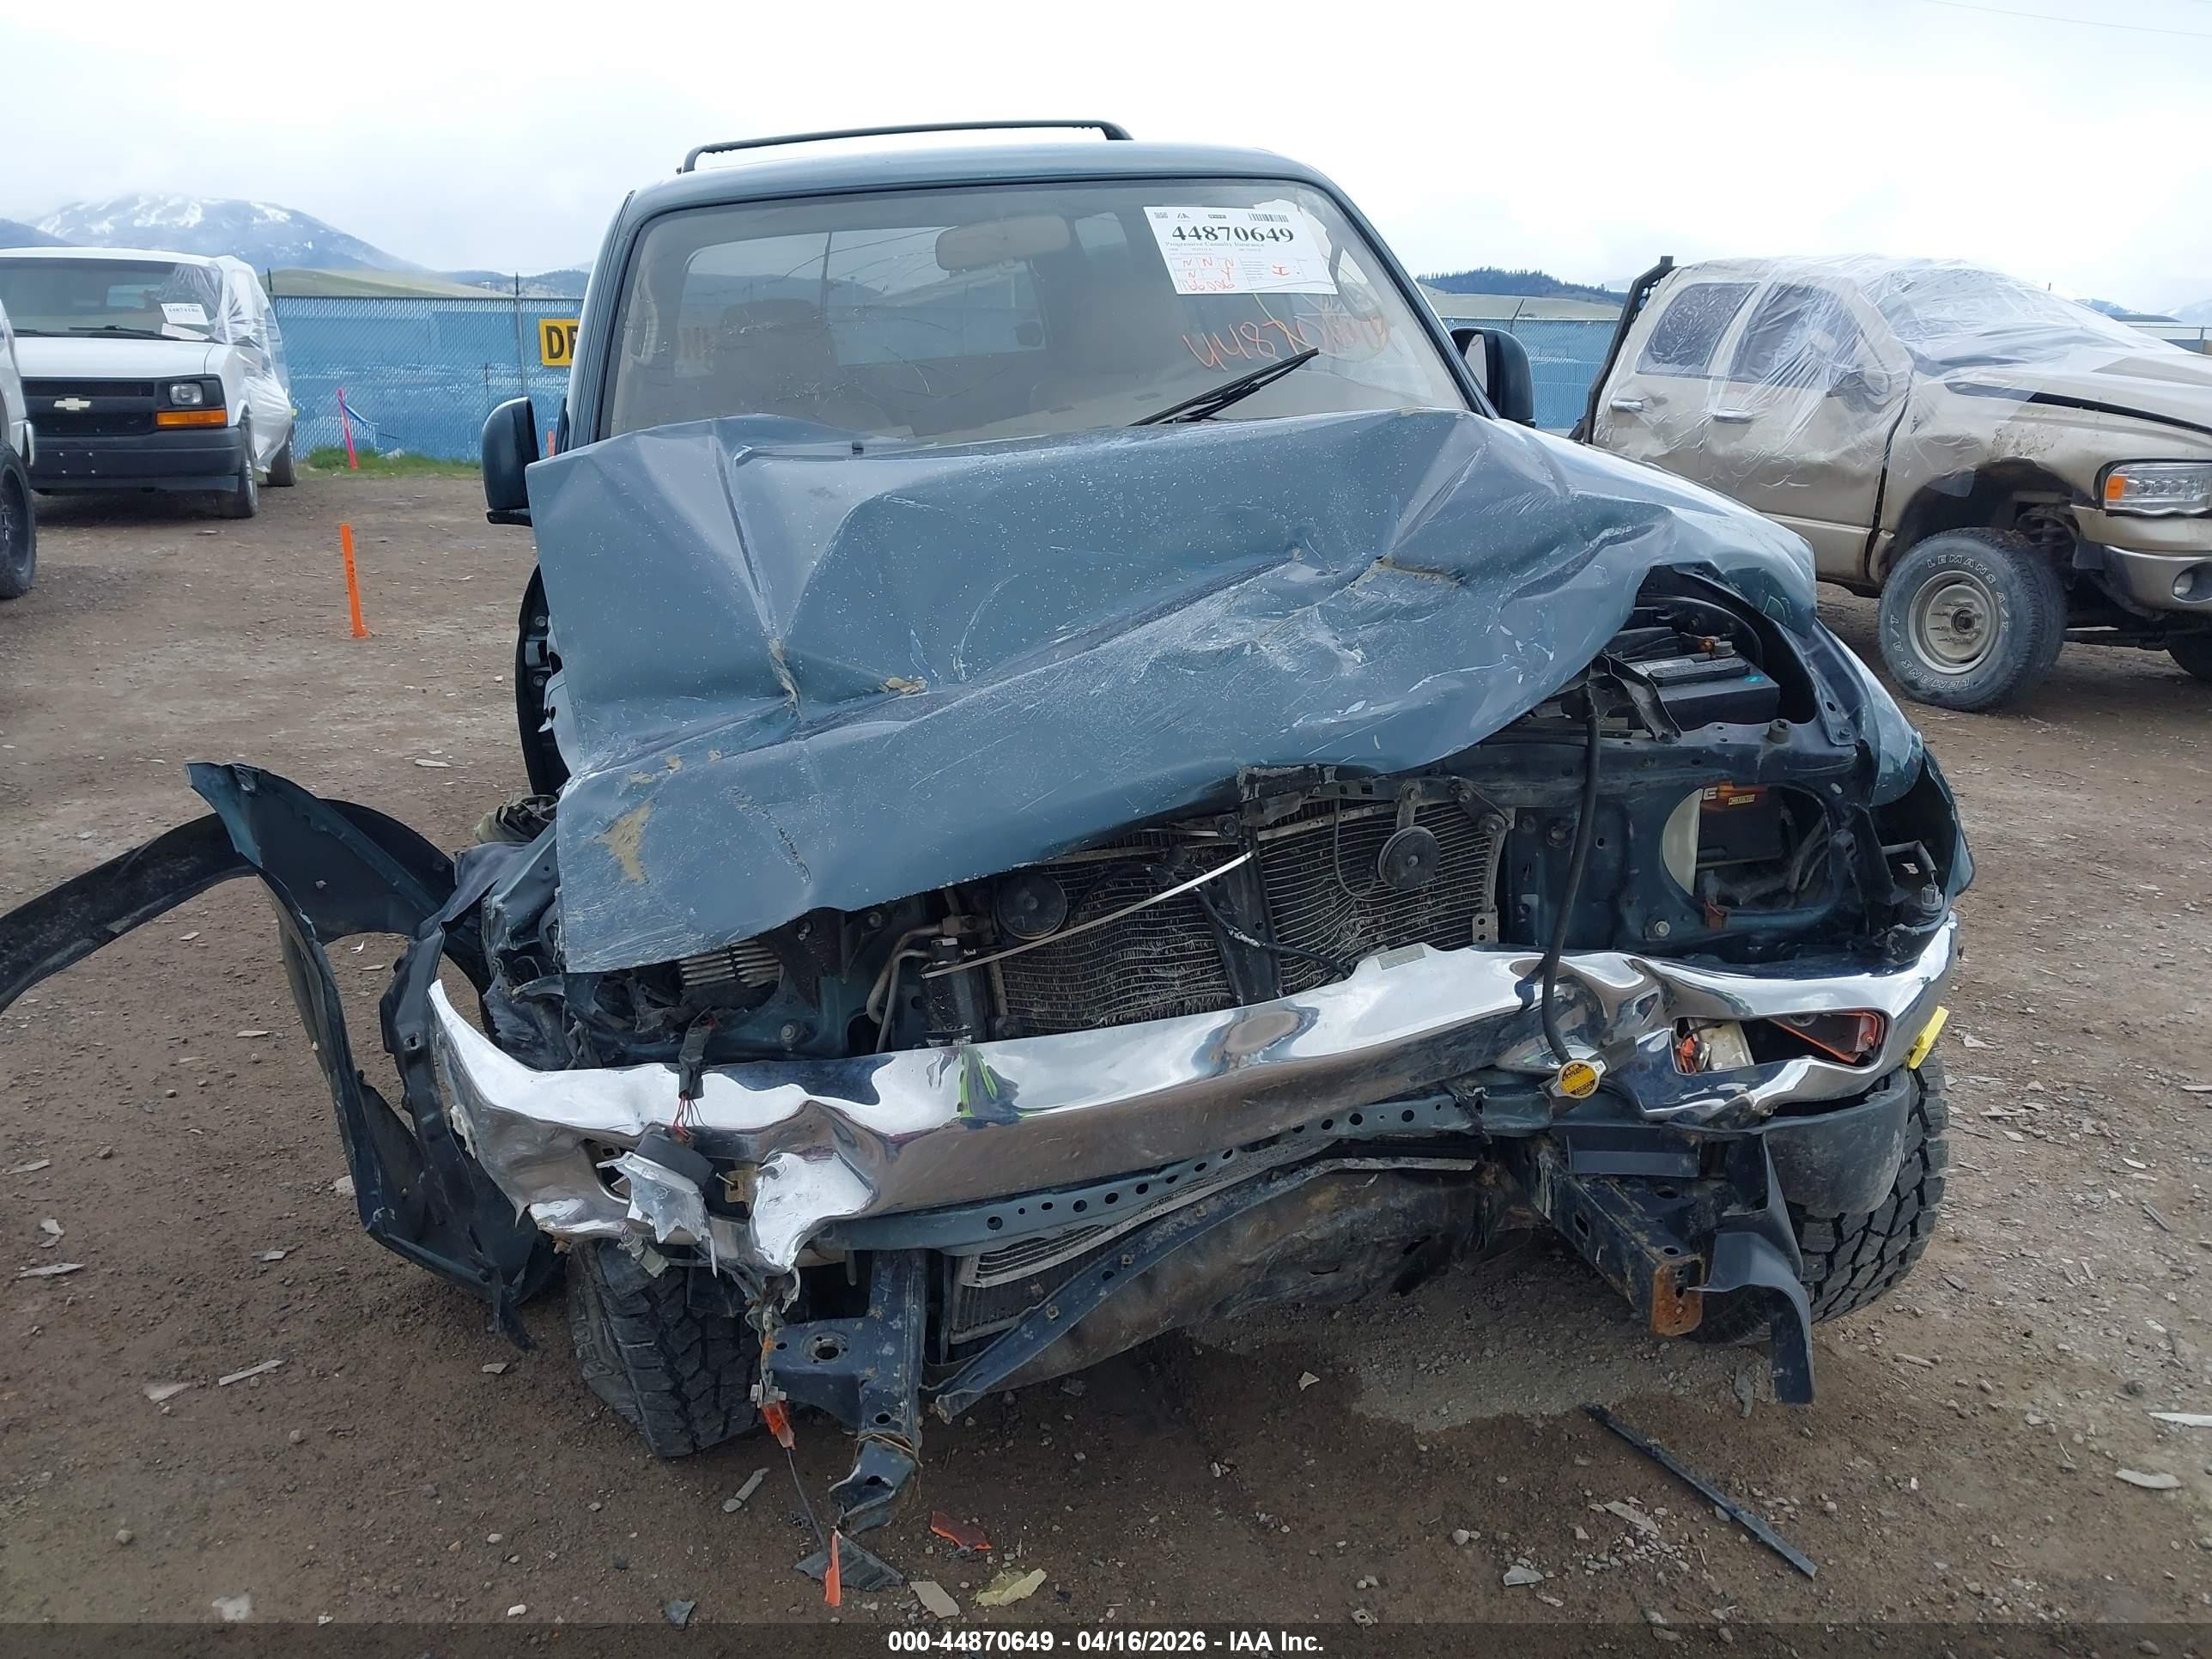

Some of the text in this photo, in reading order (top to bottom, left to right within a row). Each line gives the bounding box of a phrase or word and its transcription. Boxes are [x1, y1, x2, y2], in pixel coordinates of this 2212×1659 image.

[1172, 226, 1294, 243] 44870649
[1927, 554, 2010, 632] LEMANS A/T
[1890, 614, 1971, 690] LEMANS A/T
